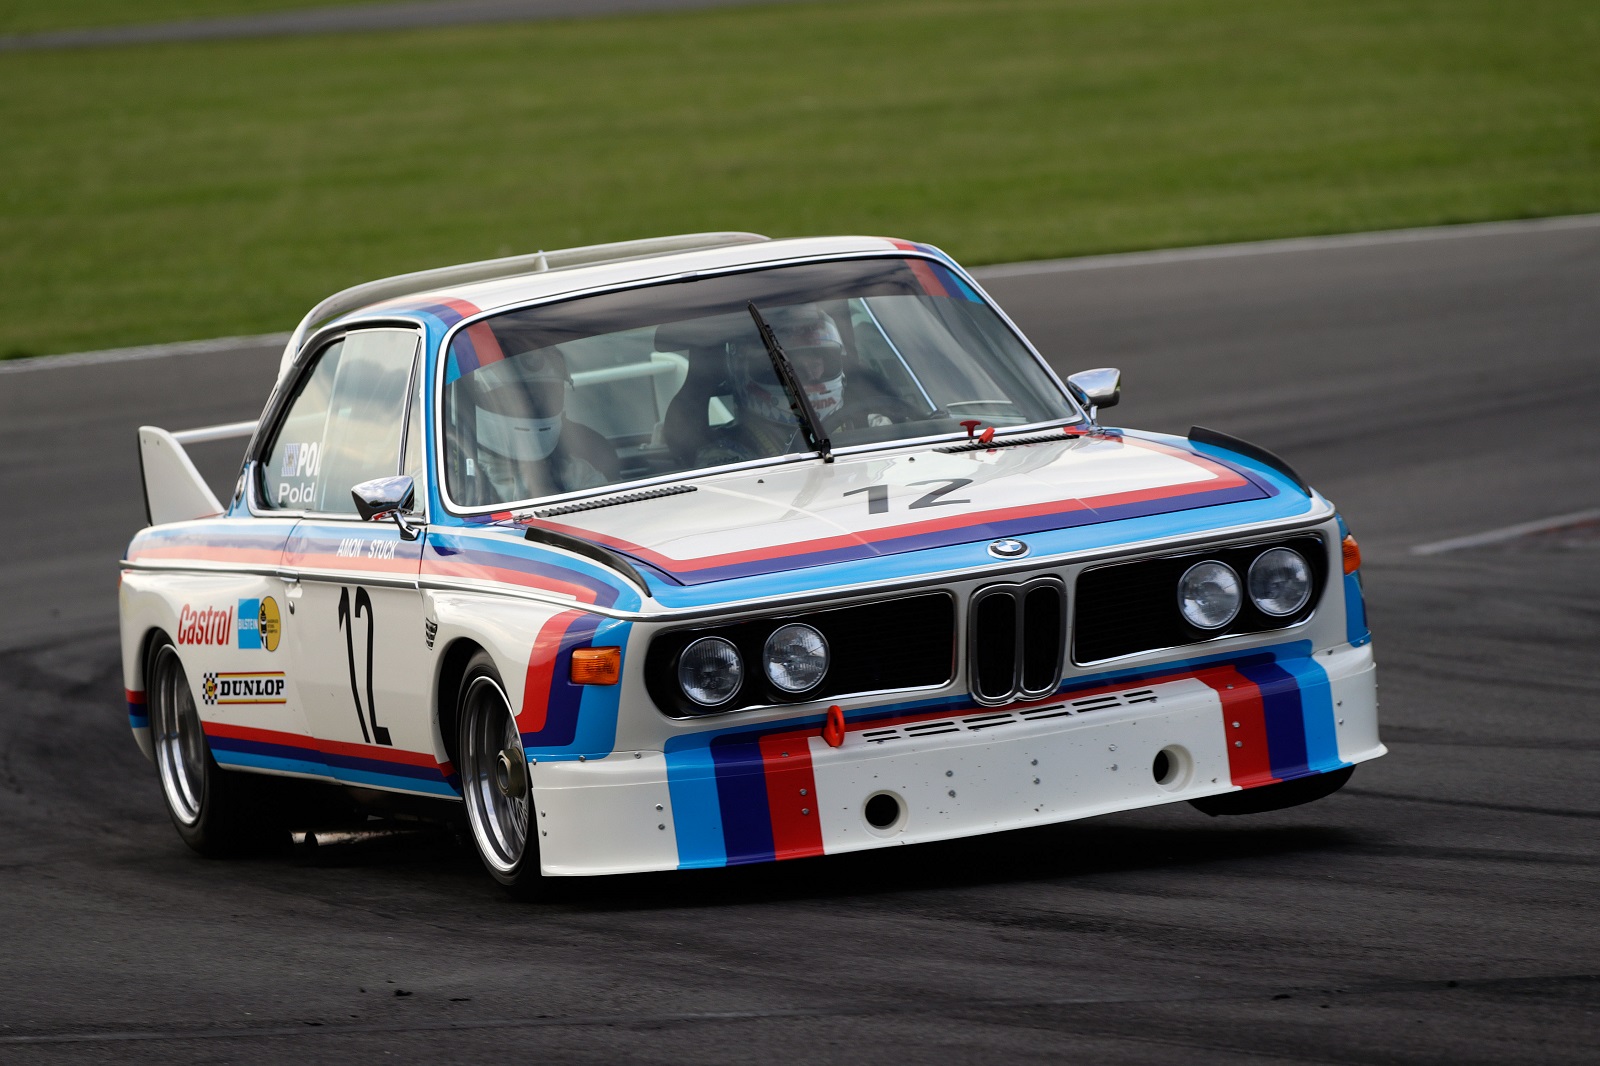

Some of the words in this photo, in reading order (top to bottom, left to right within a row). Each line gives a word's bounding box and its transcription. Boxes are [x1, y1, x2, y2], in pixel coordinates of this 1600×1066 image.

[278, 482, 316, 503] Pold
[843, 478, 974, 515] 12
[368, 539, 399, 560] STUCK
[178, 603, 233, 646] Castrol
[338, 586, 393, 746] 12
[220, 679, 285, 696] DUNLOP
